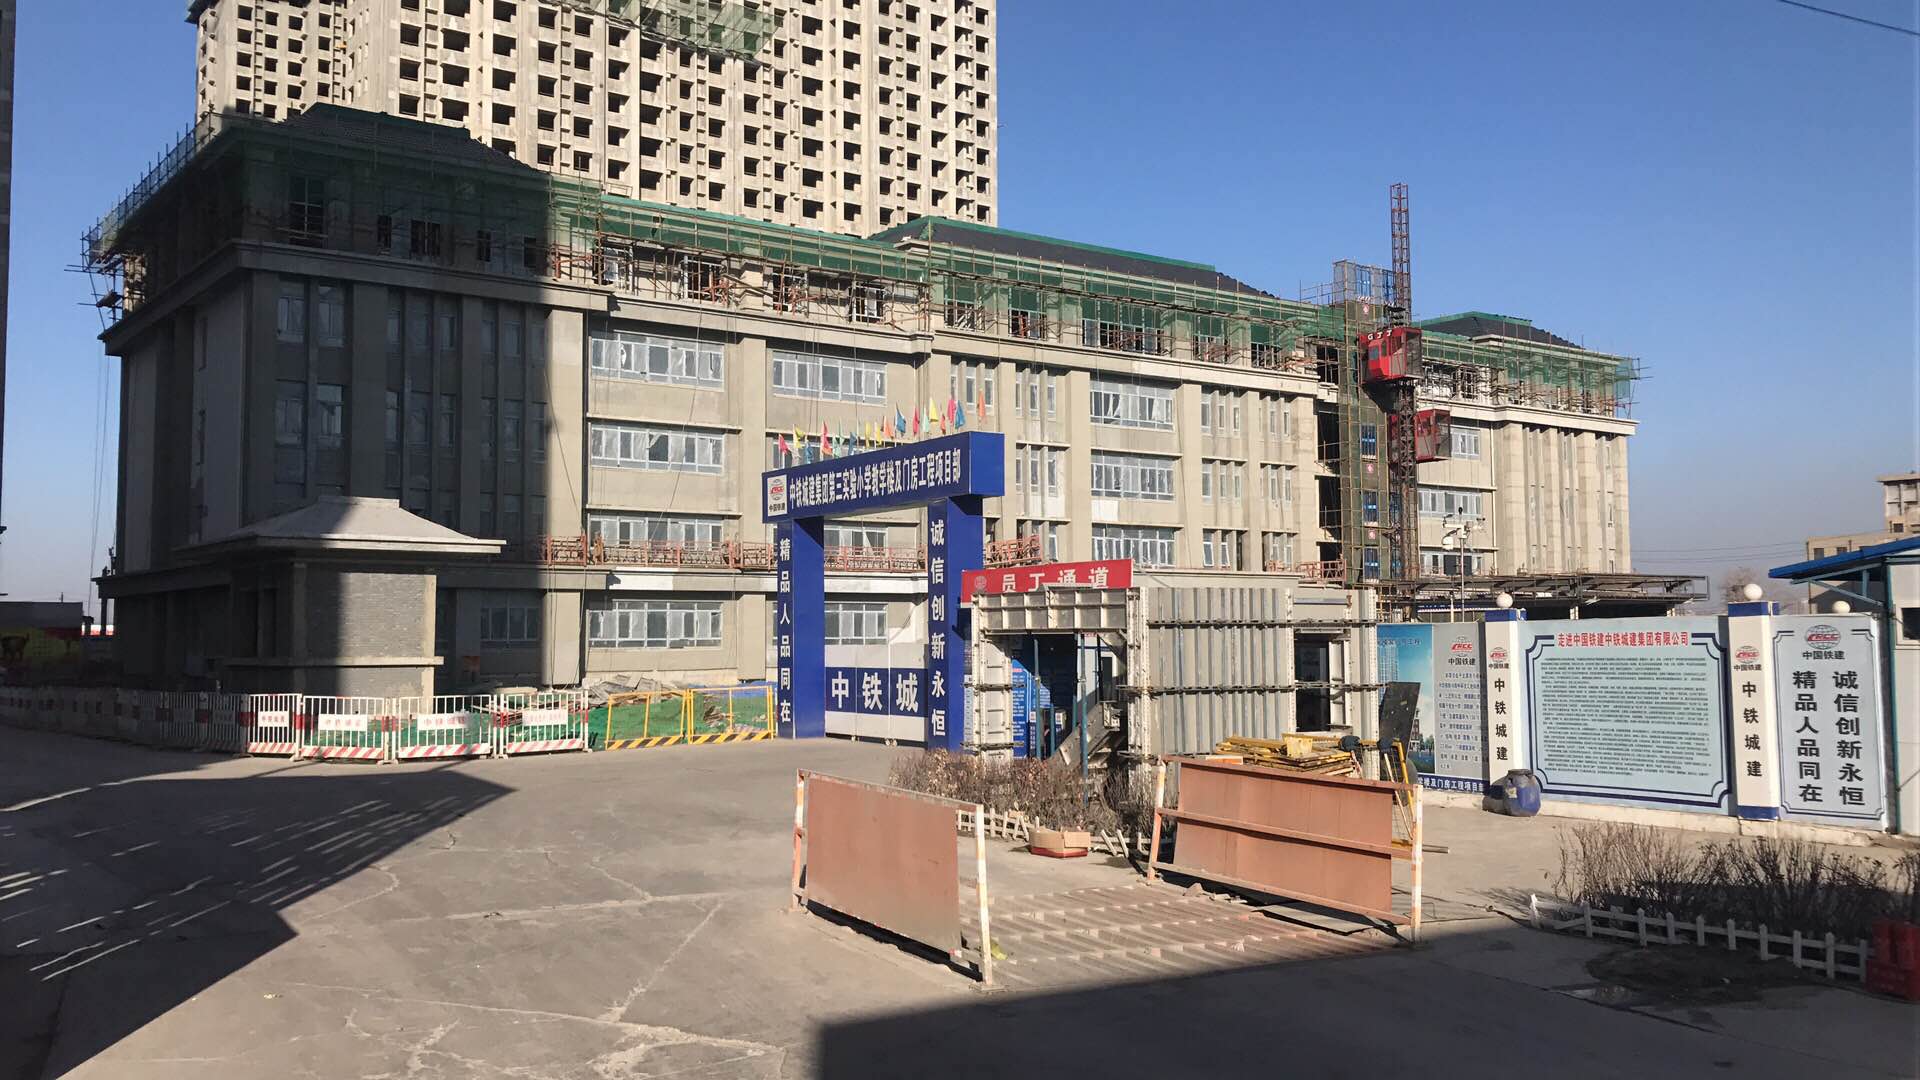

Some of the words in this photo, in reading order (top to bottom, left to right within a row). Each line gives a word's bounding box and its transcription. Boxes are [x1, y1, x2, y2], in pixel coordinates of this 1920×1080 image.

[790, 448, 961, 510] 中铁城建集团第三实验小学教学楼及门房工程项目部
[1002, 567, 1109, 592] 员工通道
[780, 538, 791, 723] 精品人品同在
[930, 520, 946, 737] 诚信创新永恒
[1558, 632, 1688, 647] 走进中国铁建中铁城建集团有限公司
[1802, 650, 1845, 660] 中国铁建
[831, 671, 918, 713] 中铁城
[1448, 657, 1476, 666] 中国铁建
[1734, 664, 1762, 672] 中国铁建
[1494, 678, 1508, 761] 中铁城建
[1742, 681, 1762, 777] 中铁城建
[1792, 670, 1823, 803] 精品人品同在
[1832, 670, 1866, 806] 诚信创新永恒
